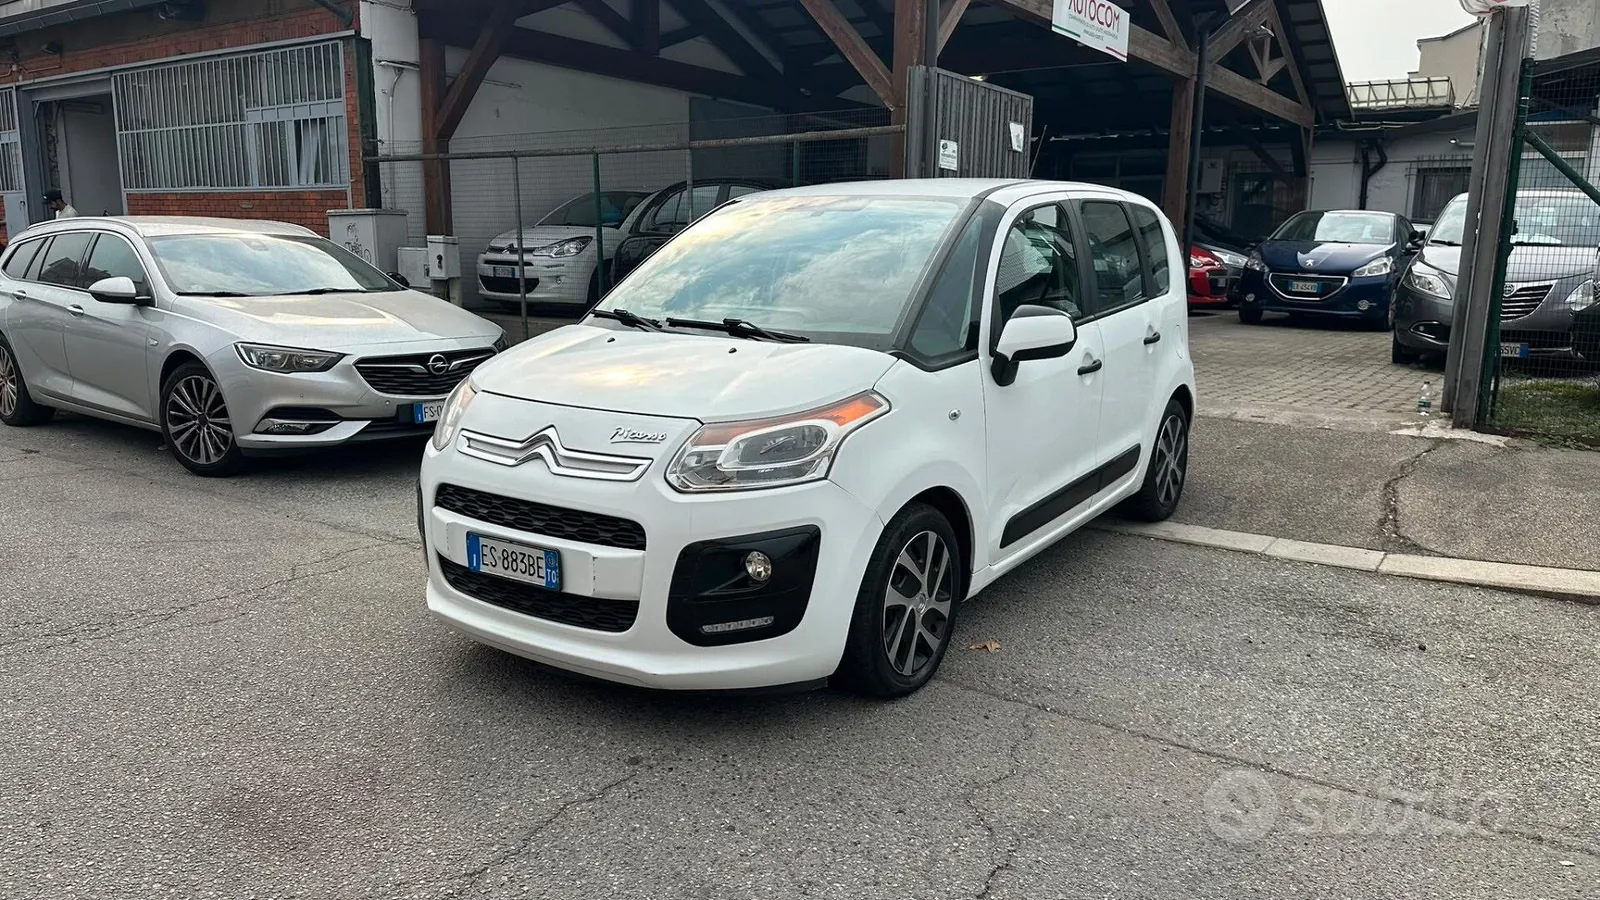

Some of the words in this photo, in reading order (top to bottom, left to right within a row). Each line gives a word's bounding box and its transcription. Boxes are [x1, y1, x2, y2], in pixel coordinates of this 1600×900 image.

[481, 544, 498, 568] ES
[501, 548, 545, 579] 883BE
[546, 568, 557, 583] TO
